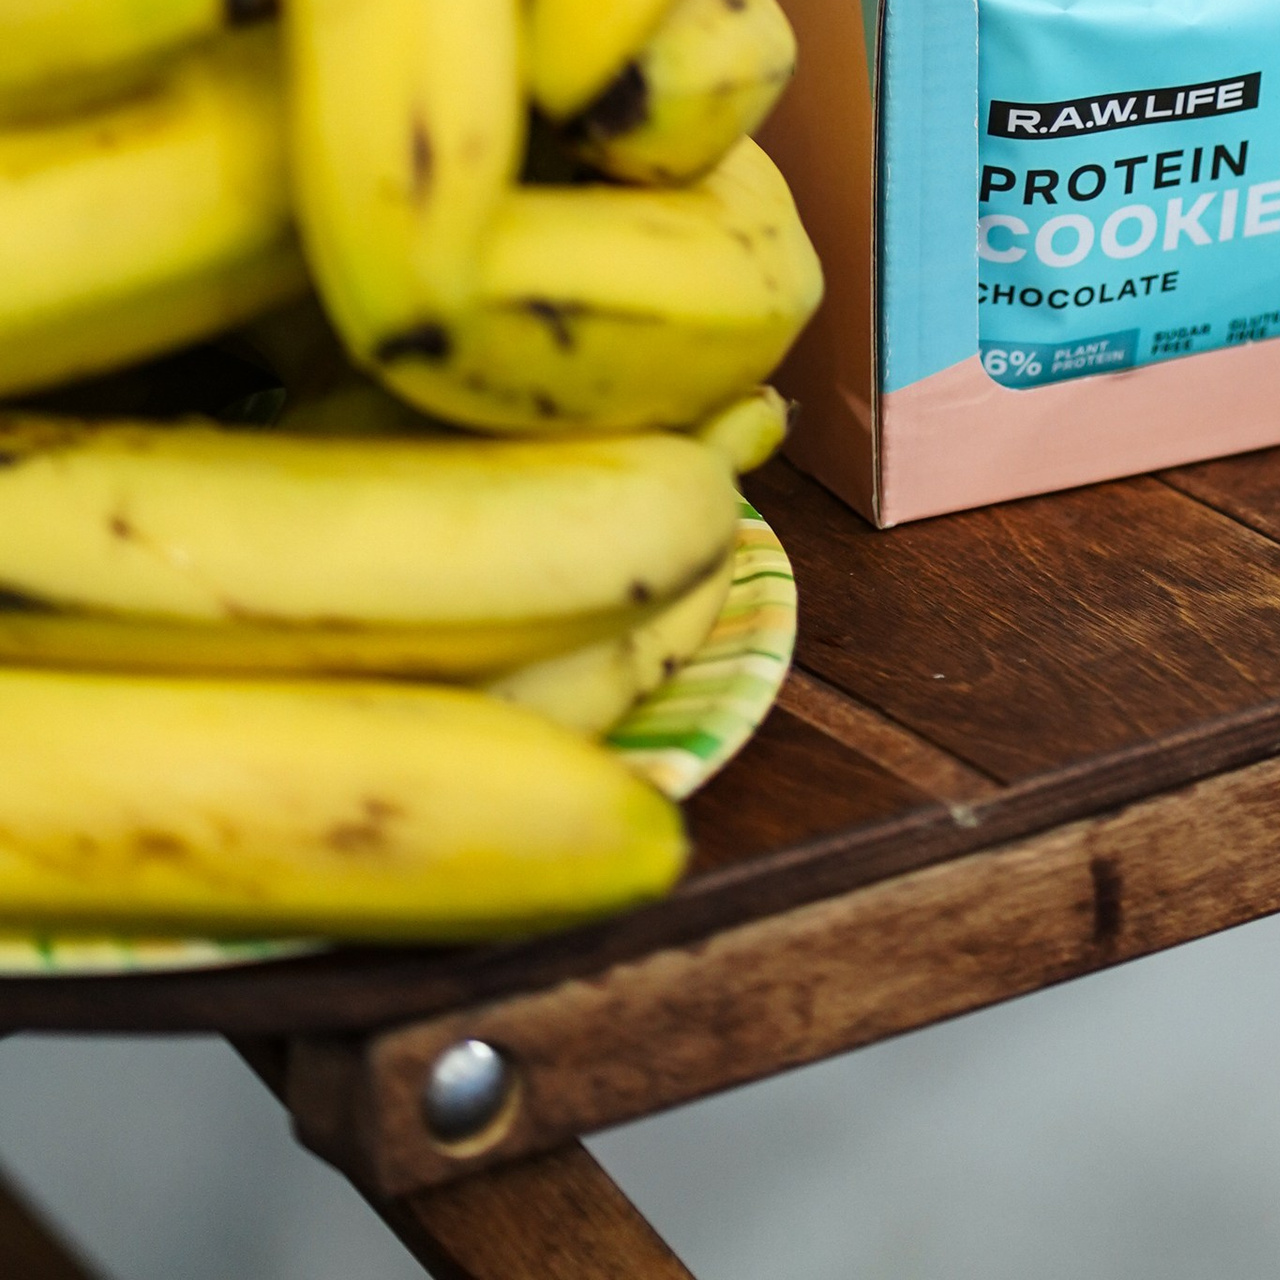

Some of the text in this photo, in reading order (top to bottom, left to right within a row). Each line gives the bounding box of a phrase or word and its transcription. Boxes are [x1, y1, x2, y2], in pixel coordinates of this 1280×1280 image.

[979, 141, 1248, 205] PROTEIN
[978, 348, 1042, 377] 6%
[1051, 350, 1125, 373] PROTEIN
[1054, 340, 1109, 361] PLANT
